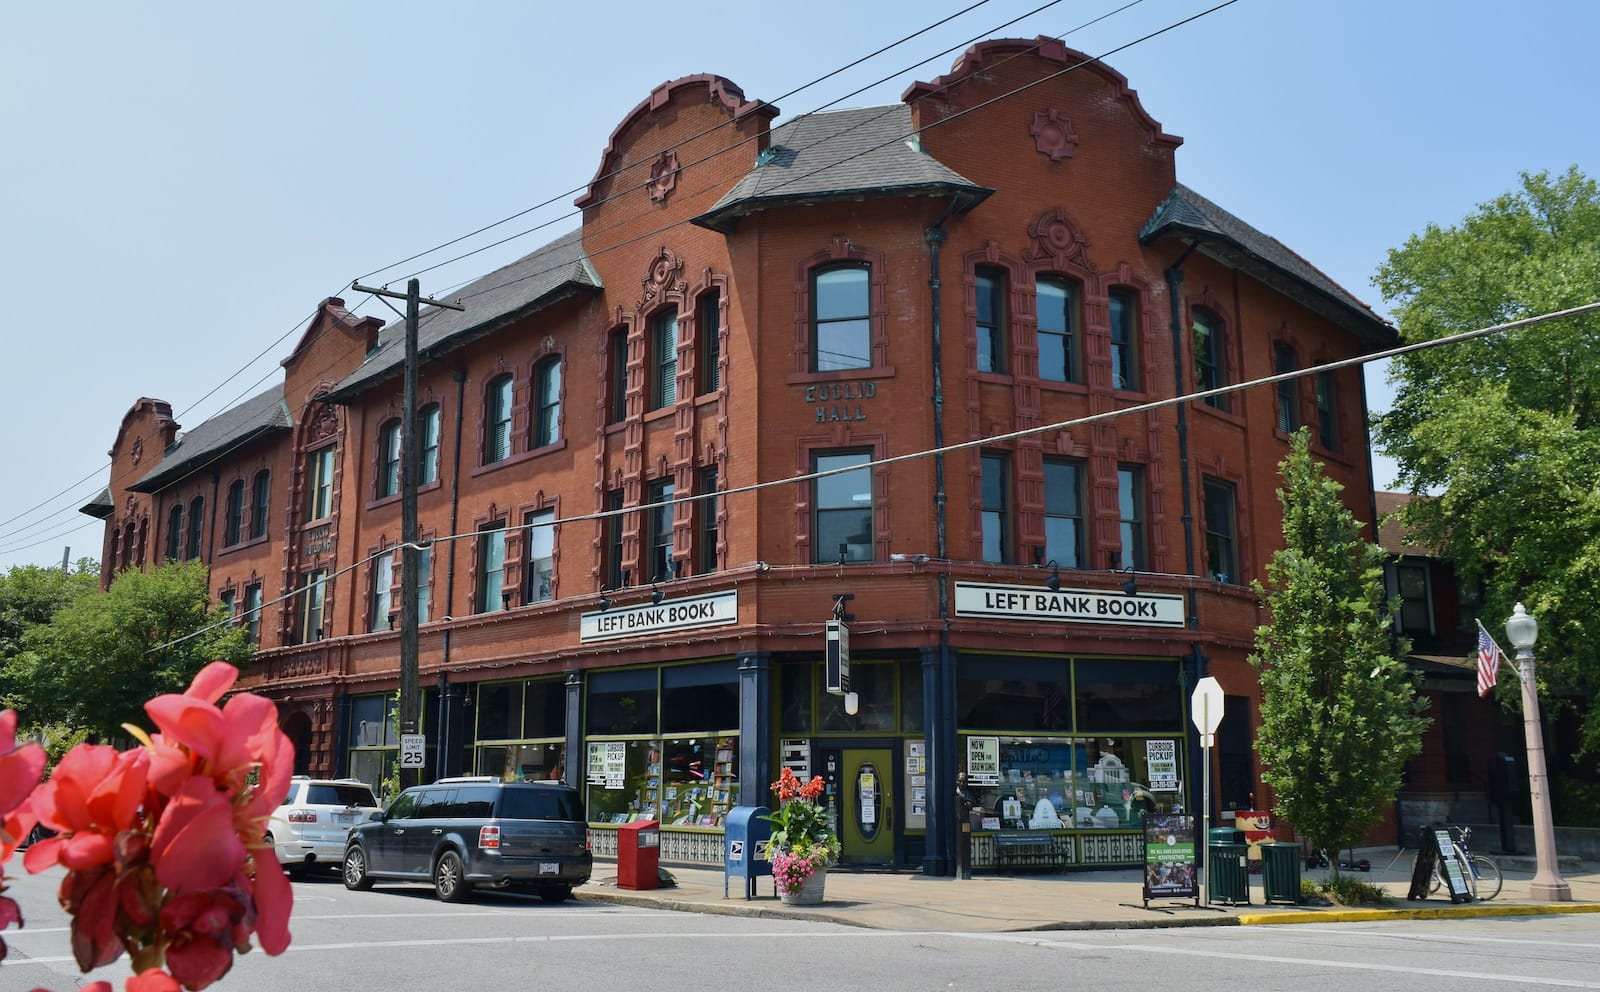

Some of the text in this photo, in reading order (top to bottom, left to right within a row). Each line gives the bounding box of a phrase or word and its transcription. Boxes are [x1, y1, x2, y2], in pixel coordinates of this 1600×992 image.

[804, 381, 876, 403] EUCLID
[815, 403, 867, 423] HALL
[985, 592, 1158, 618] LEFT BANK BOOKS
[597, 601, 715, 633] LEFT BANK BOOKS
[971, 740, 985, 750] NOW
[1148, 742, 1173, 751] CURBSIDE
[403, 752, 423, 764] 25
[971, 751, 985, 761] OPEN
[1149, 751, 1174, 761] PICKUP
